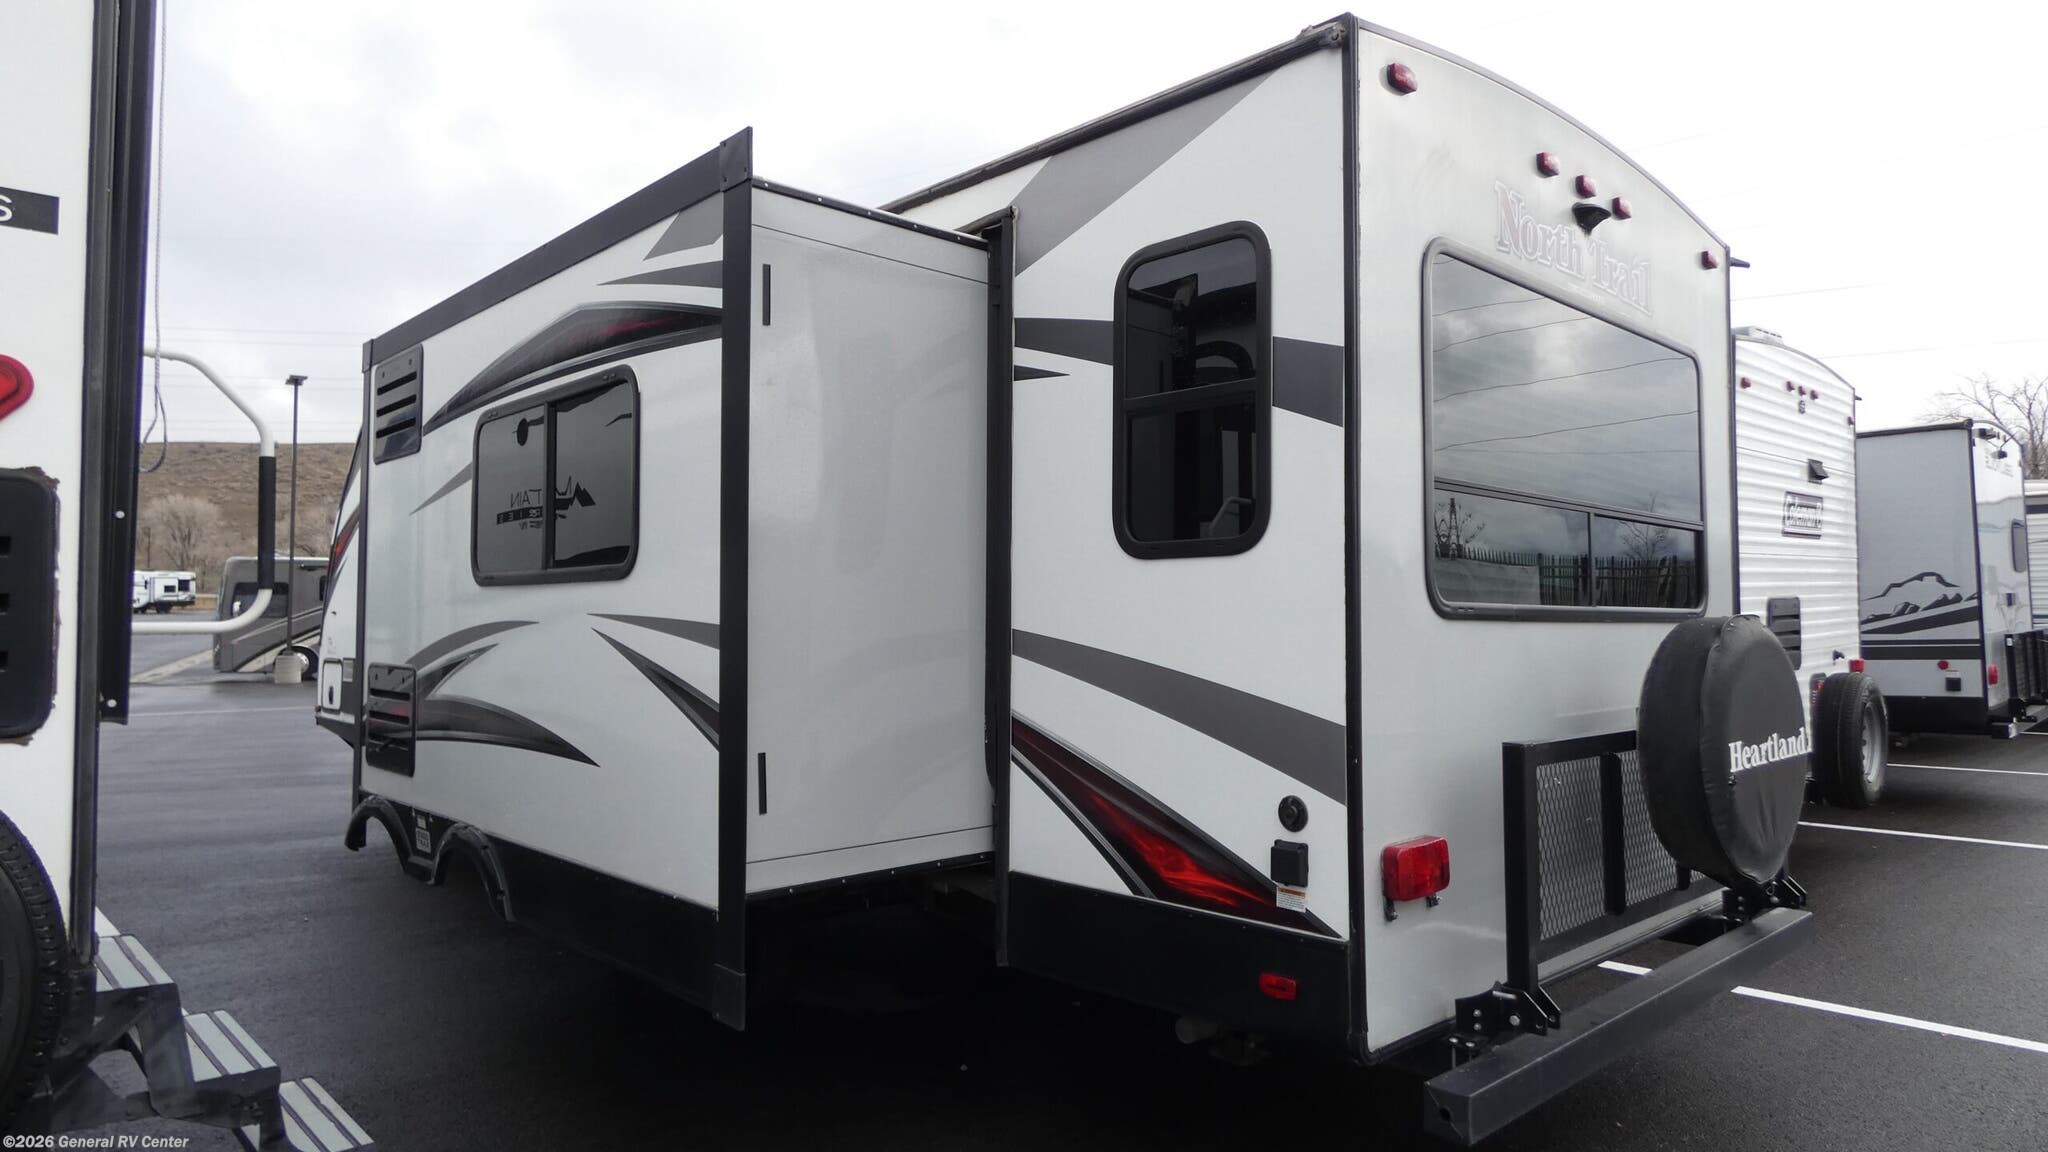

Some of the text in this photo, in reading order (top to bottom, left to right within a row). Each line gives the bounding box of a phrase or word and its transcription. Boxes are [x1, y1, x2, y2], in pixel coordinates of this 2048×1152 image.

[1494, 180, 1653, 317] North Trail
[1728, 727, 1807, 773] Heartland
